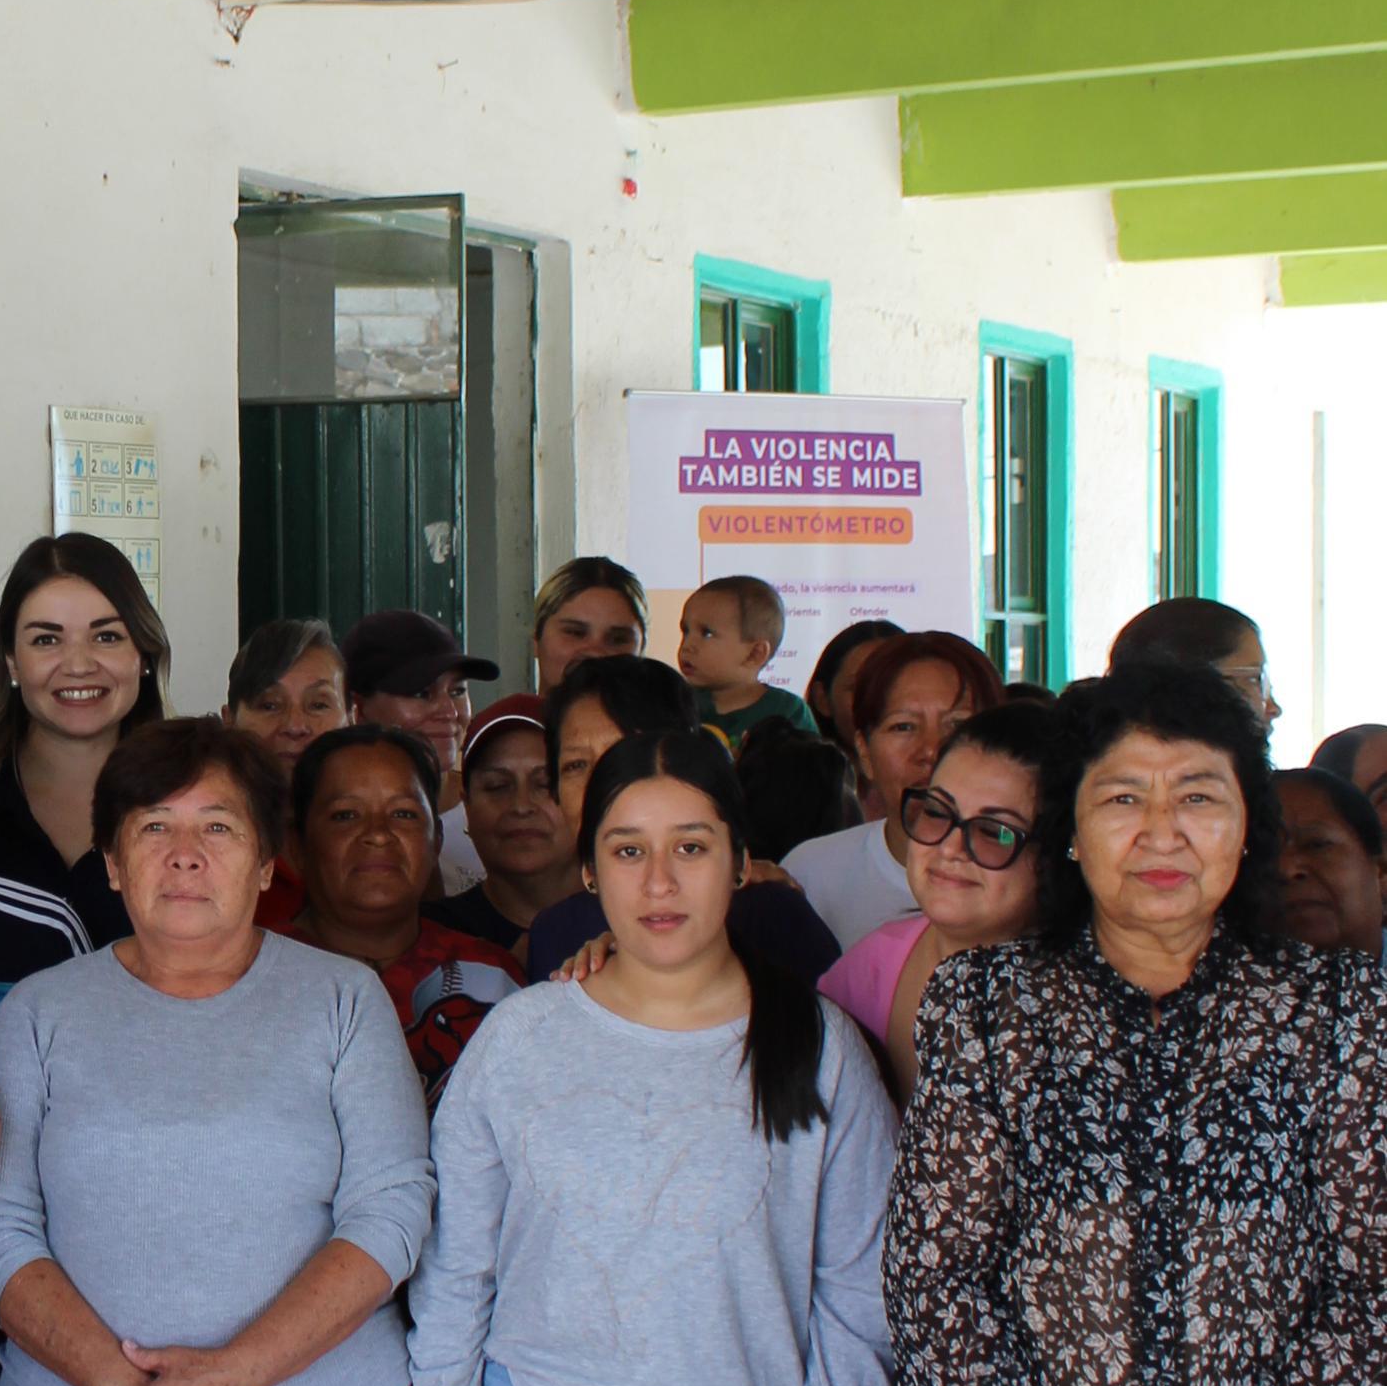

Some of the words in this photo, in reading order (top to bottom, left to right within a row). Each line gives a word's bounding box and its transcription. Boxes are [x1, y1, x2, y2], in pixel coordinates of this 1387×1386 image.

[709, 437, 742, 459] LA
[750, 437, 892, 462] VIOLENCIA
[91, 459, 97, 474] 2
[126, 461, 132, 475] 3
[682, 461, 803, 488] TAMBIÉN
[812, 465, 842, 488] SE
[852, 467, 918, 490] MIDE
[708, 512, 905, 535] VIOLENTÓMETRO
